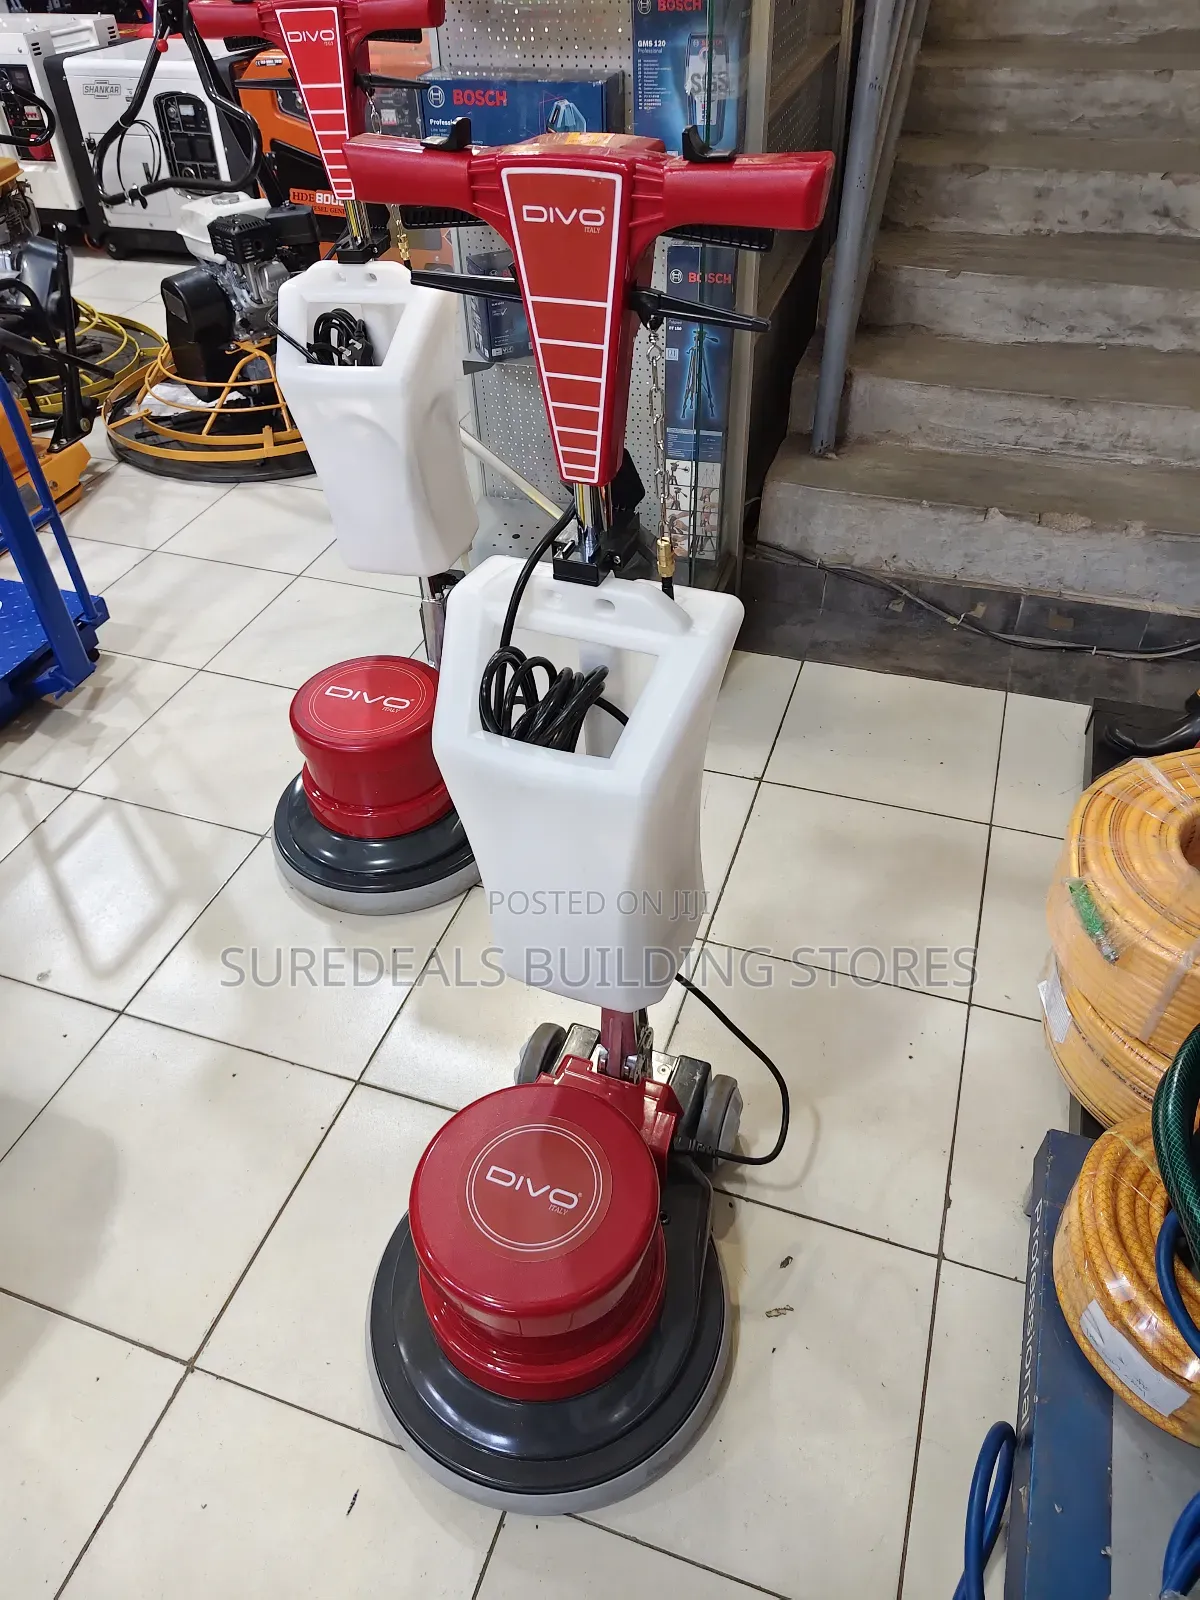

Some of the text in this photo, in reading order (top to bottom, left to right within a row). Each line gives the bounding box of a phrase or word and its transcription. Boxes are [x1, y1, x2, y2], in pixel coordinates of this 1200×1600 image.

[657, 0, 703, 11] BOSCH
[286, 29, 335, 43] DIVO
[637, 39, 666, 47] GMS 120
[84, 85, 120, 94] SHANKAR
[452, 89, 507, 107] BOSCH
[522, 204, 605, 227] DIVO
[584, 226, 601, 234] ITALY
[688, 271, 732, 285] BOSCH
[324, 685, 411, 710] DIVO
[485, 1165, 579, 1209] DIVO
[548, 1203, 569, 1216] ITALY
[1017, 1197, 1045, 1432] Professional
